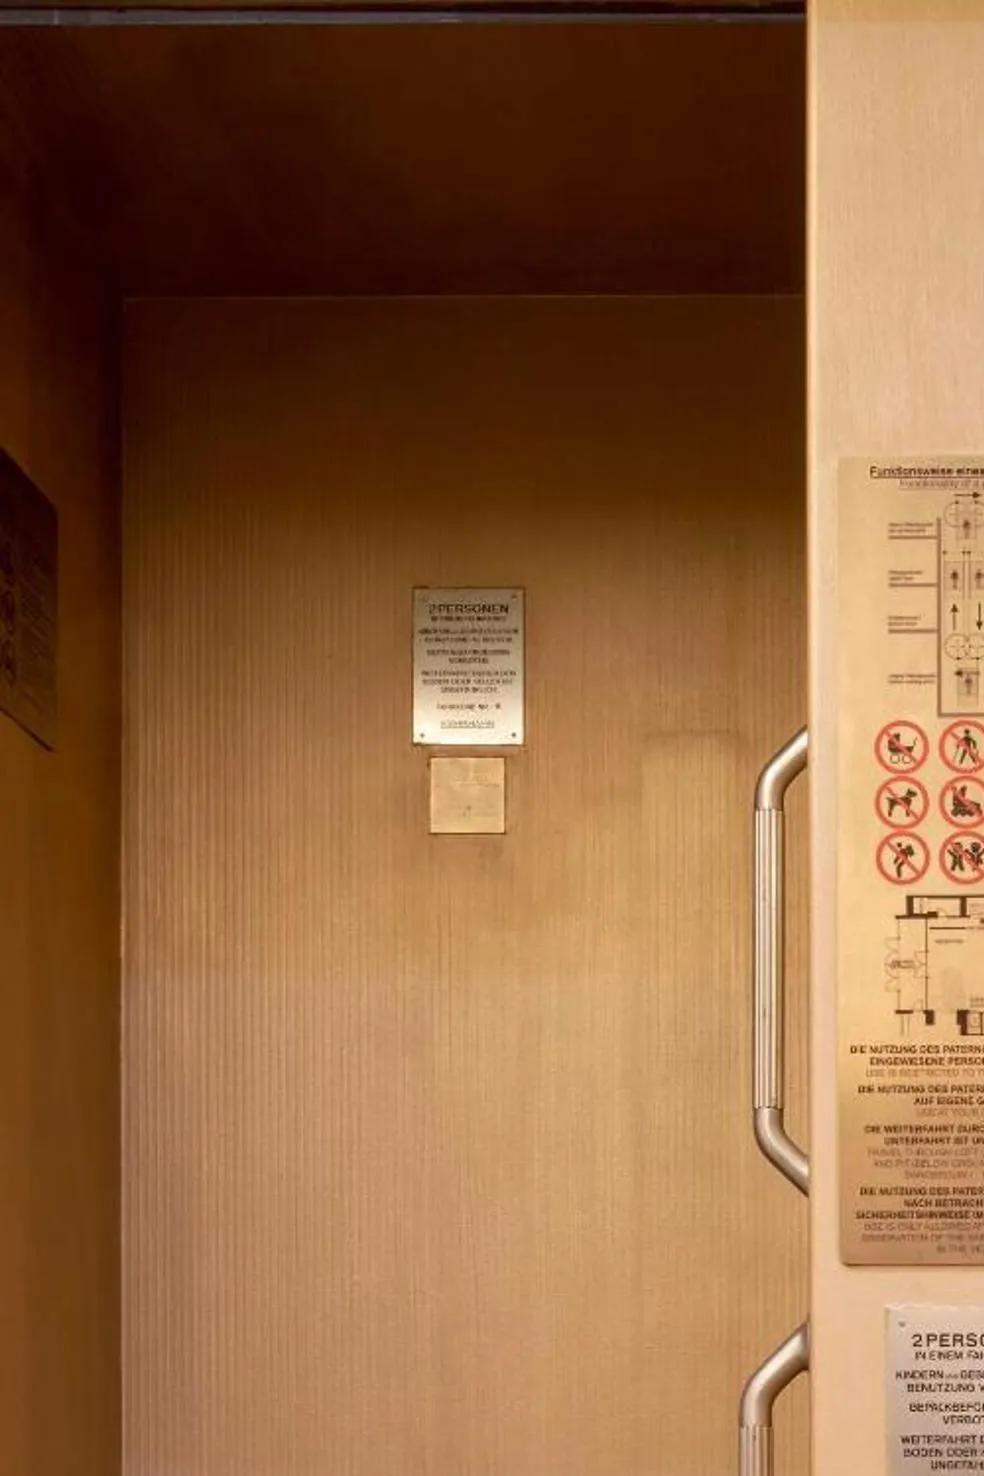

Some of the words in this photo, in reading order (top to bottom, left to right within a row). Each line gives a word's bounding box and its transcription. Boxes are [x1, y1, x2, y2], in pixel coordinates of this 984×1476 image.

[869, 1045, 919, 1055] NUTZUNG
[928, 1350, 964, 1361] EINEM
[895, 1369, 944, 1380] KINDERN
[907, 1382, 975, 1393] BENUTZUNG
[903, 1447, 943, 1457] BODEN
[946, 1447, 978, 1457] ODER
